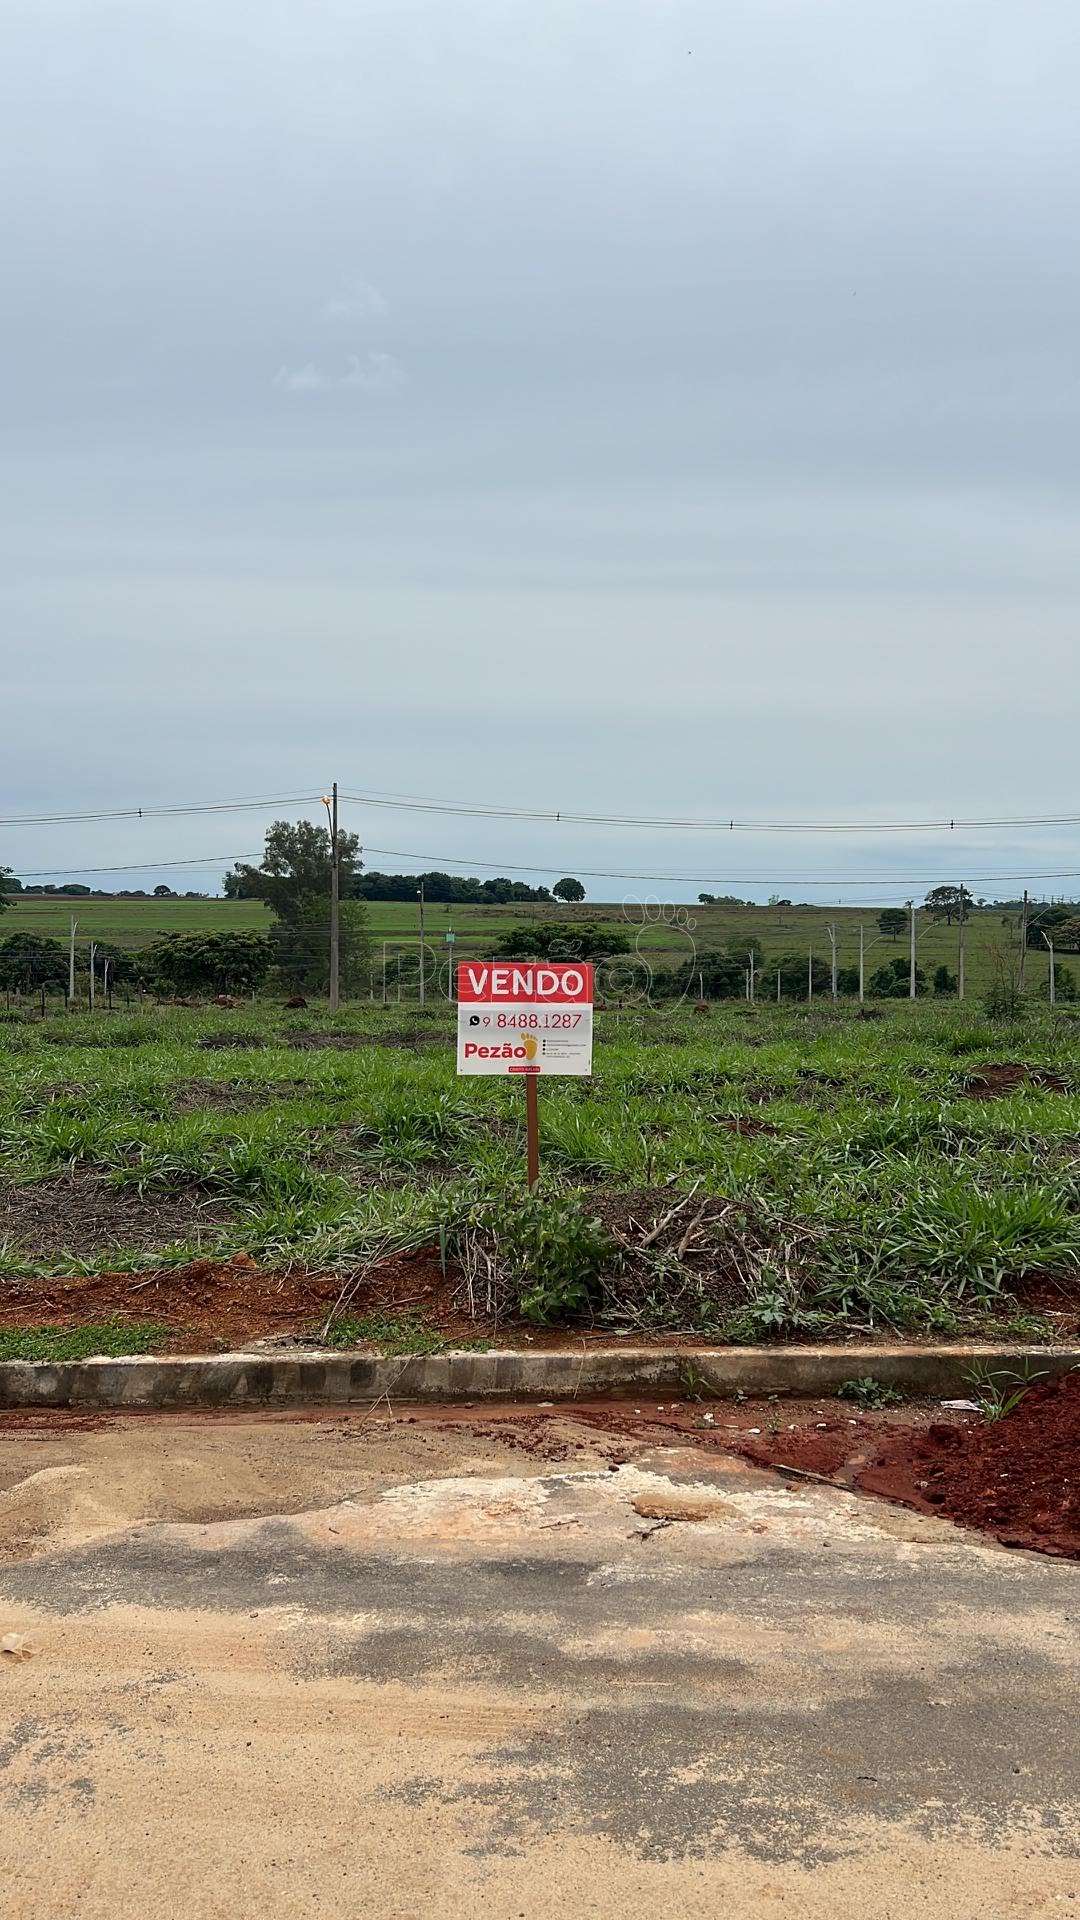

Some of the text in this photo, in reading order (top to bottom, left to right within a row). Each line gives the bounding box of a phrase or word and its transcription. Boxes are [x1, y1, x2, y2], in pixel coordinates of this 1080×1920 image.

[468, 968, 584, 996] VENDO
[482, 1016, 491, 1028] 9
[497, 1013, 582, 1029] 8488.1287
[464, 1042, 527, 1059] Pezão
